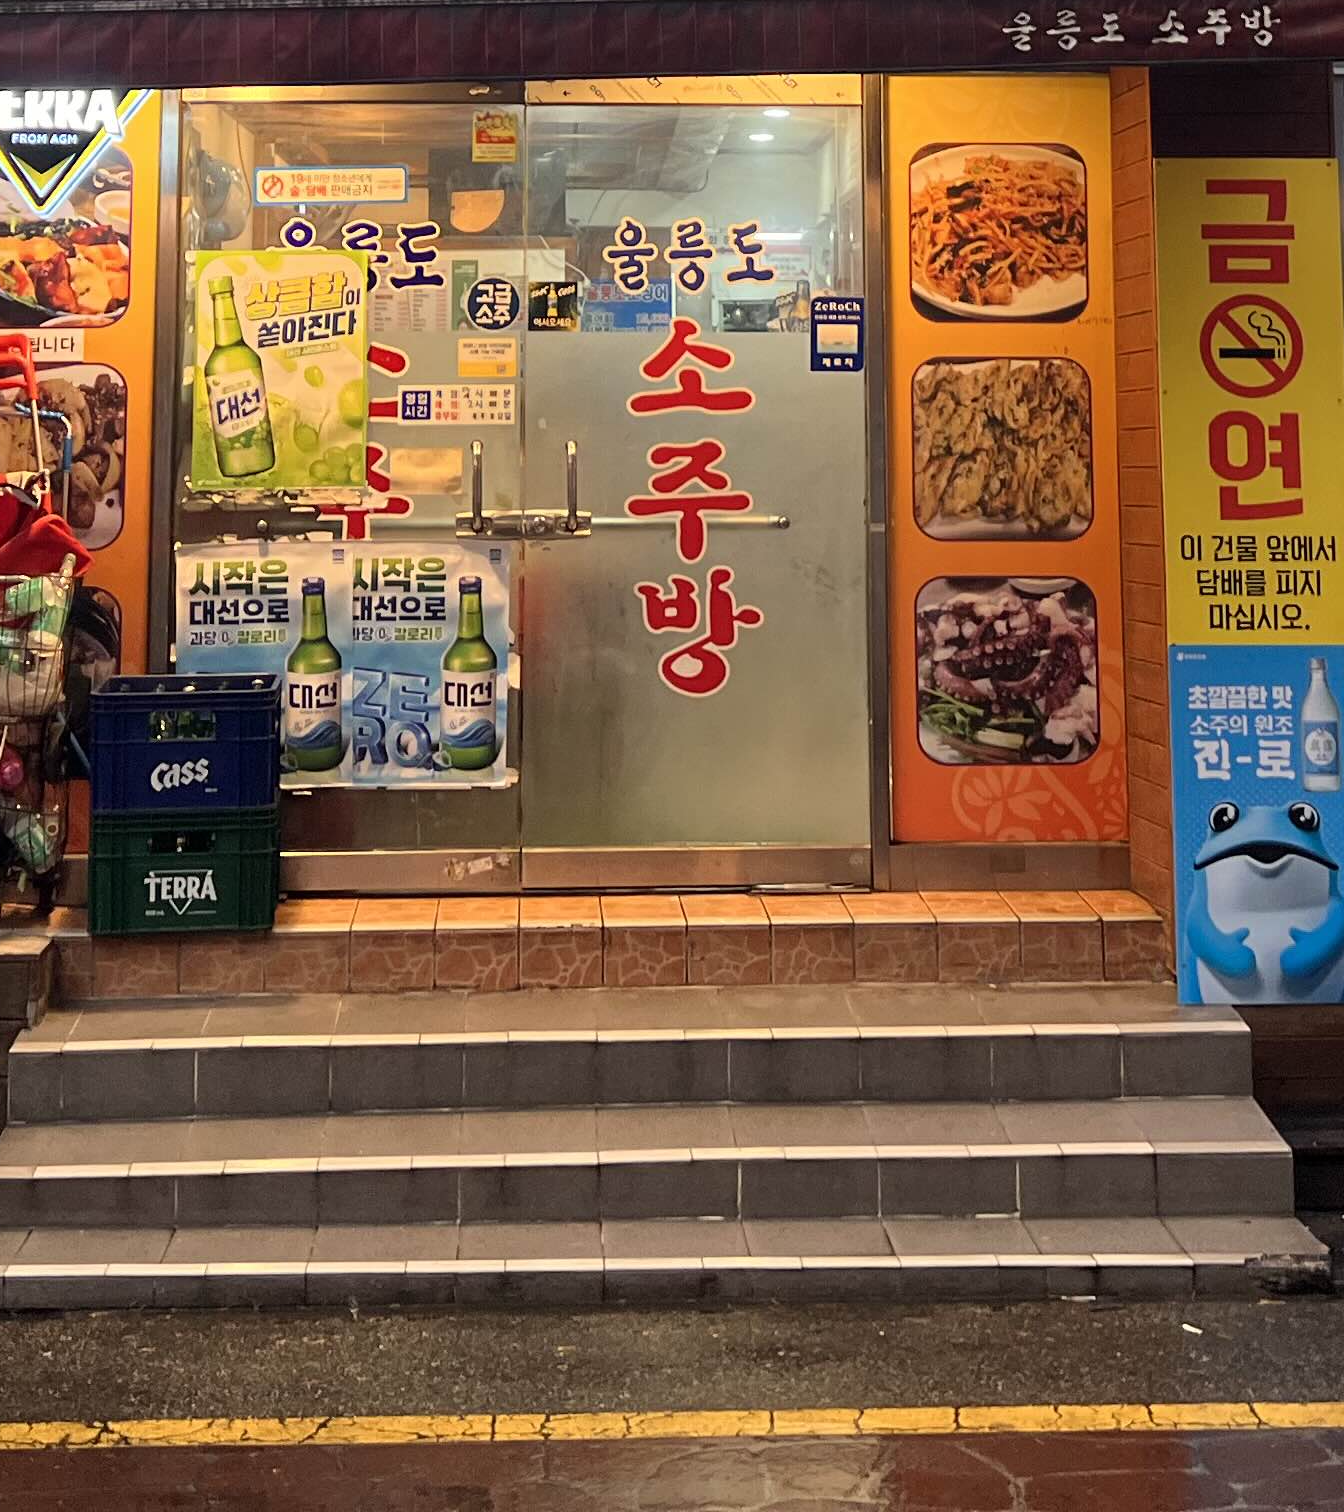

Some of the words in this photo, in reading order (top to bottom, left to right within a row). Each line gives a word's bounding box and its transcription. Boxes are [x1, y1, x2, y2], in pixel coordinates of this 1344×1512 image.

[1002, 9, 1126, 51] 울릉도
[1152, 4, 1282, 48] 소주방
[11, 133, 47, 145] FROM
[50, 133, 78, 145] AGM
[607, 220, 775, 291] 울릉도
[244, 271, 361, 321] 상큼함이
[257, 310, 357, 349] 쏟아진다
[475, 305, 512, 326] 소주
[215, 388, 261, 426] 대선
[629, 320, 761, 694] 소주방
[1180, 534, 1202, 561] 이
[1212, 535, 1258, 562] 건물
[1266, 535, 1337, 562] 앞에서
[189, 559, 290, 596] 시작은
[1196, 569, 1267, 596] 담배를
[1275, 569, 1322, 596] 피지
[189, 598, 290, 626] 대선으로
[1209, 603, 1311, 631] 마십시오.
[1188, 684, 1268, 710] 초깔끔한
[1272, 685, 1294, 710] 맛
[1189, 715, 1248, 737] 소주의
[1254, 714, 1294, 737] 원조
[150, 758, 209, 792] Cass
[144, 872, 217, 903] TERRA
